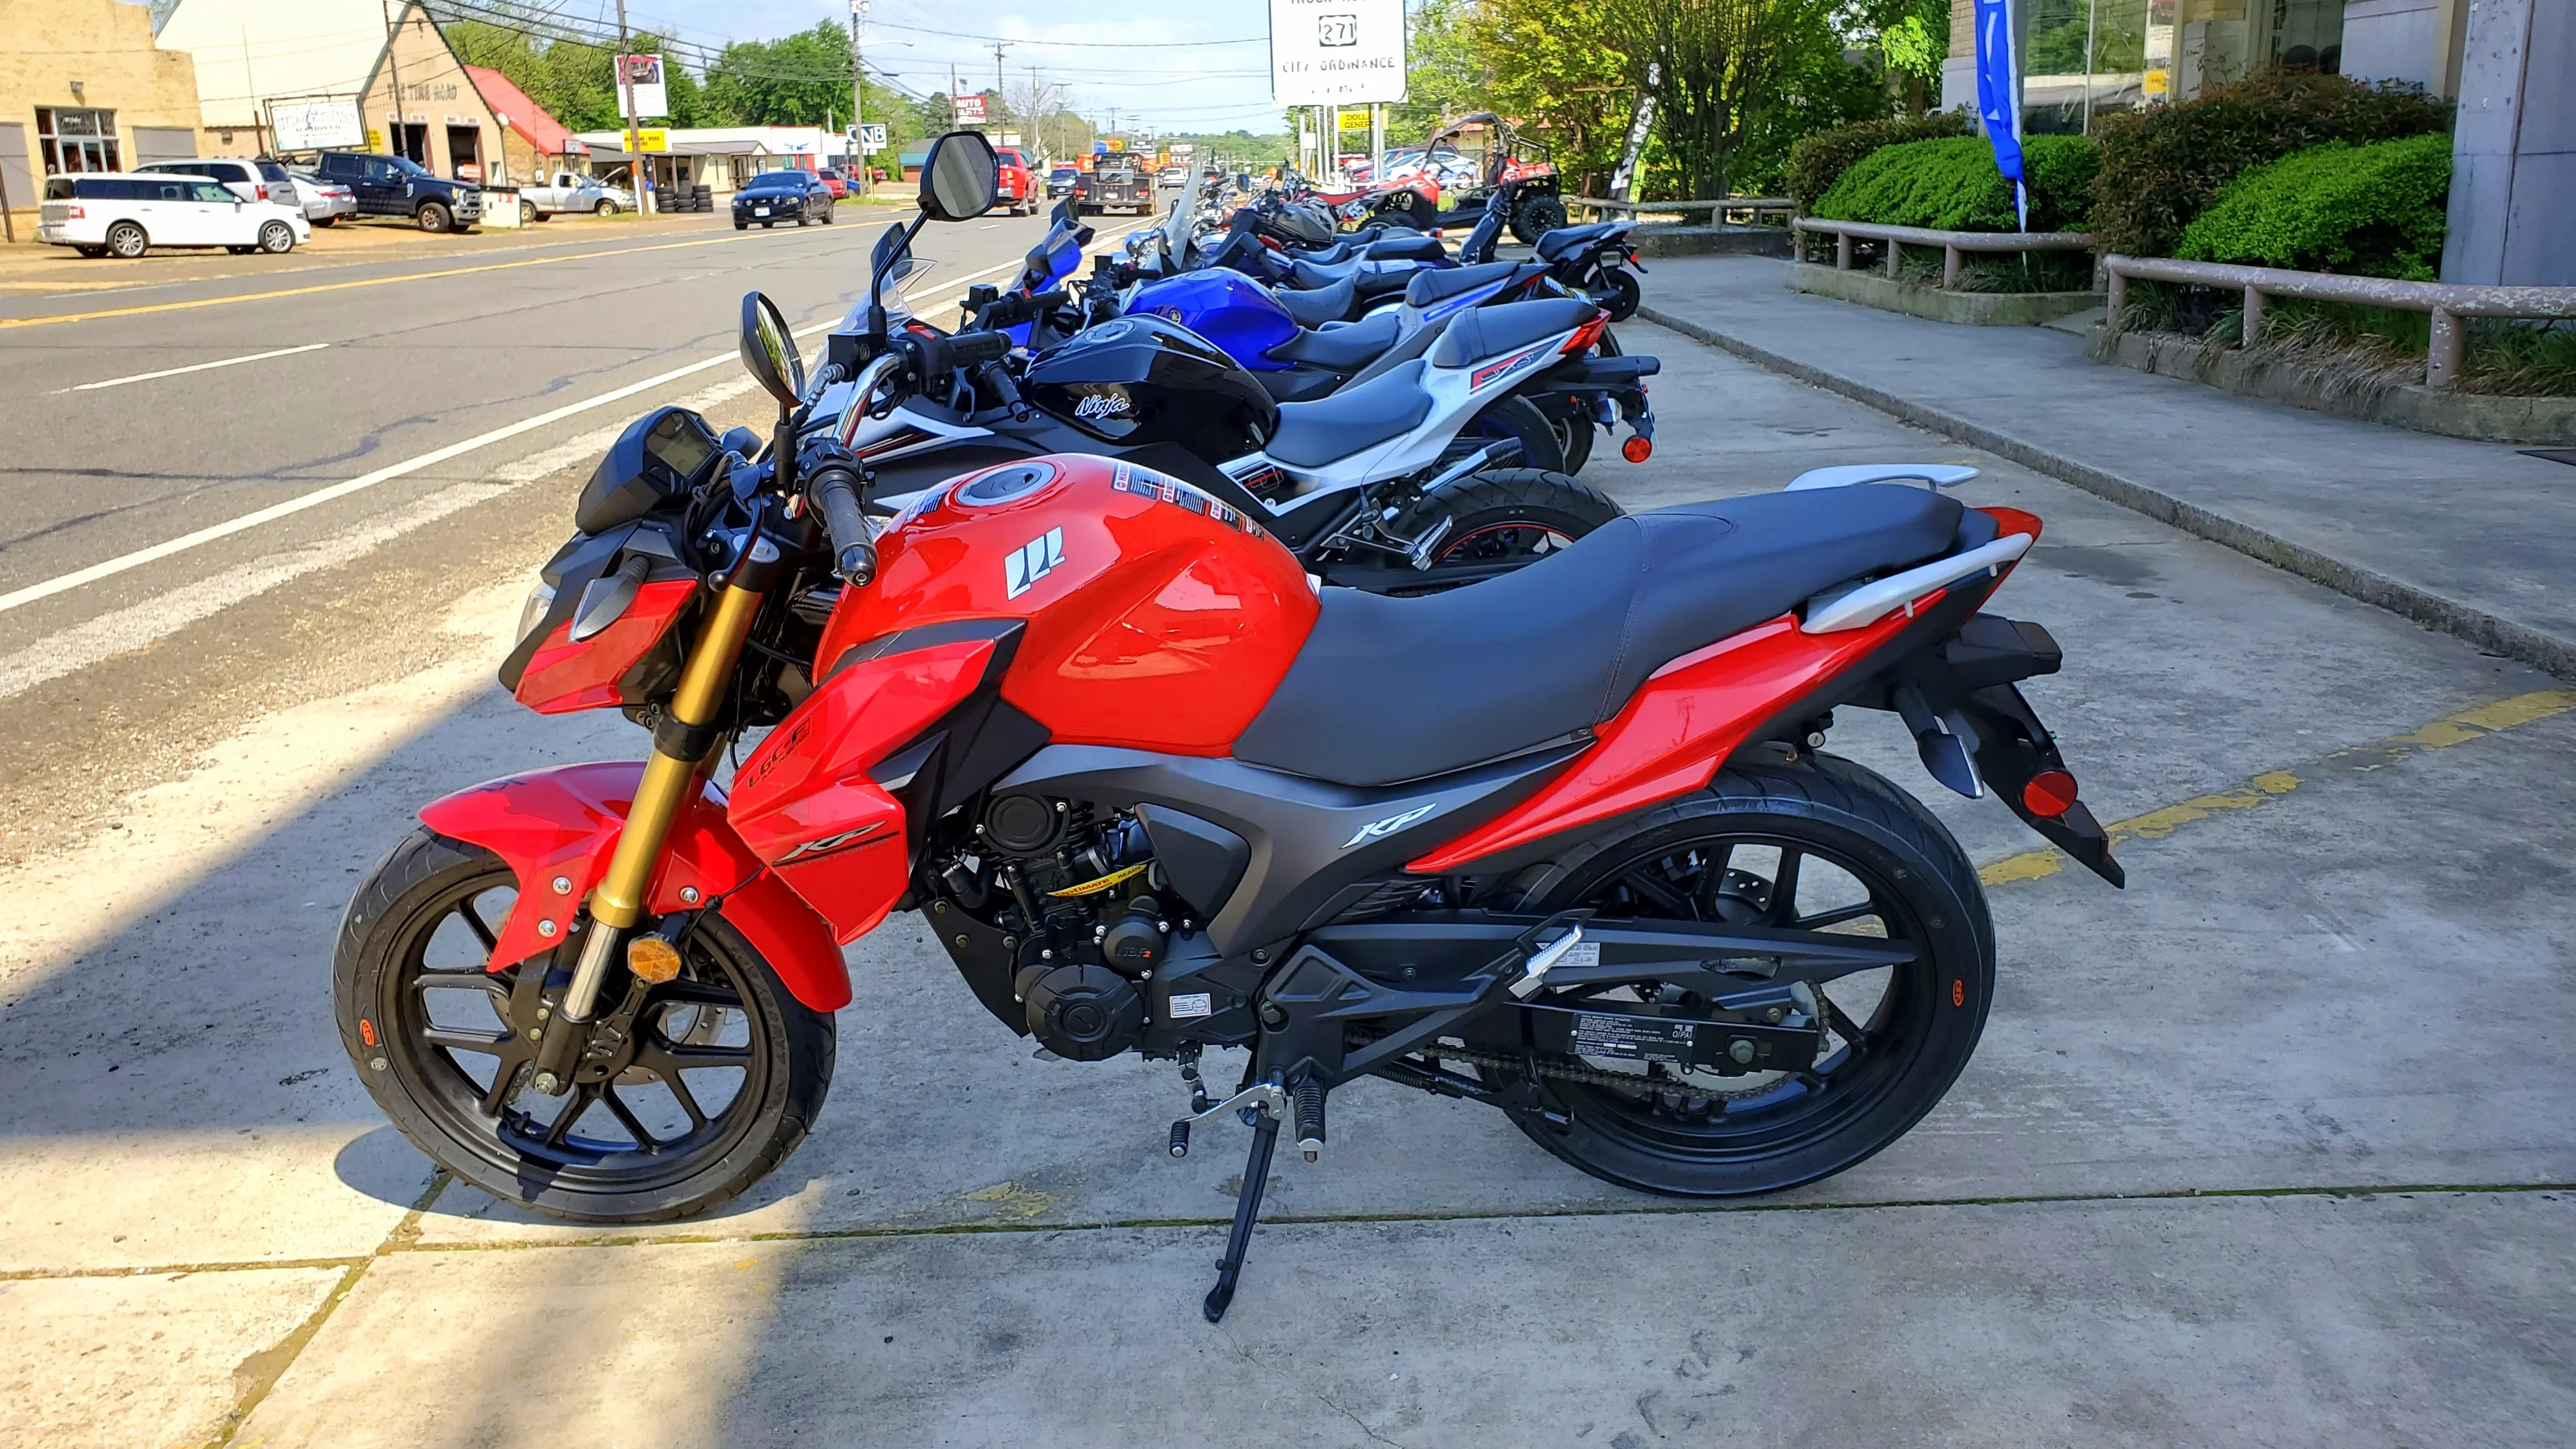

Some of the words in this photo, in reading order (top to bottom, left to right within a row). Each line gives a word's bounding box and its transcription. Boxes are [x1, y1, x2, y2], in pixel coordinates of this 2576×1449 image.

[1324, 23, 1354, 42] 271
[1320, 57, 1395, 70] ORDINANCE
[1075, 393, 1130, 420] Ninja
[1117, 866, 1142, 879] READY
